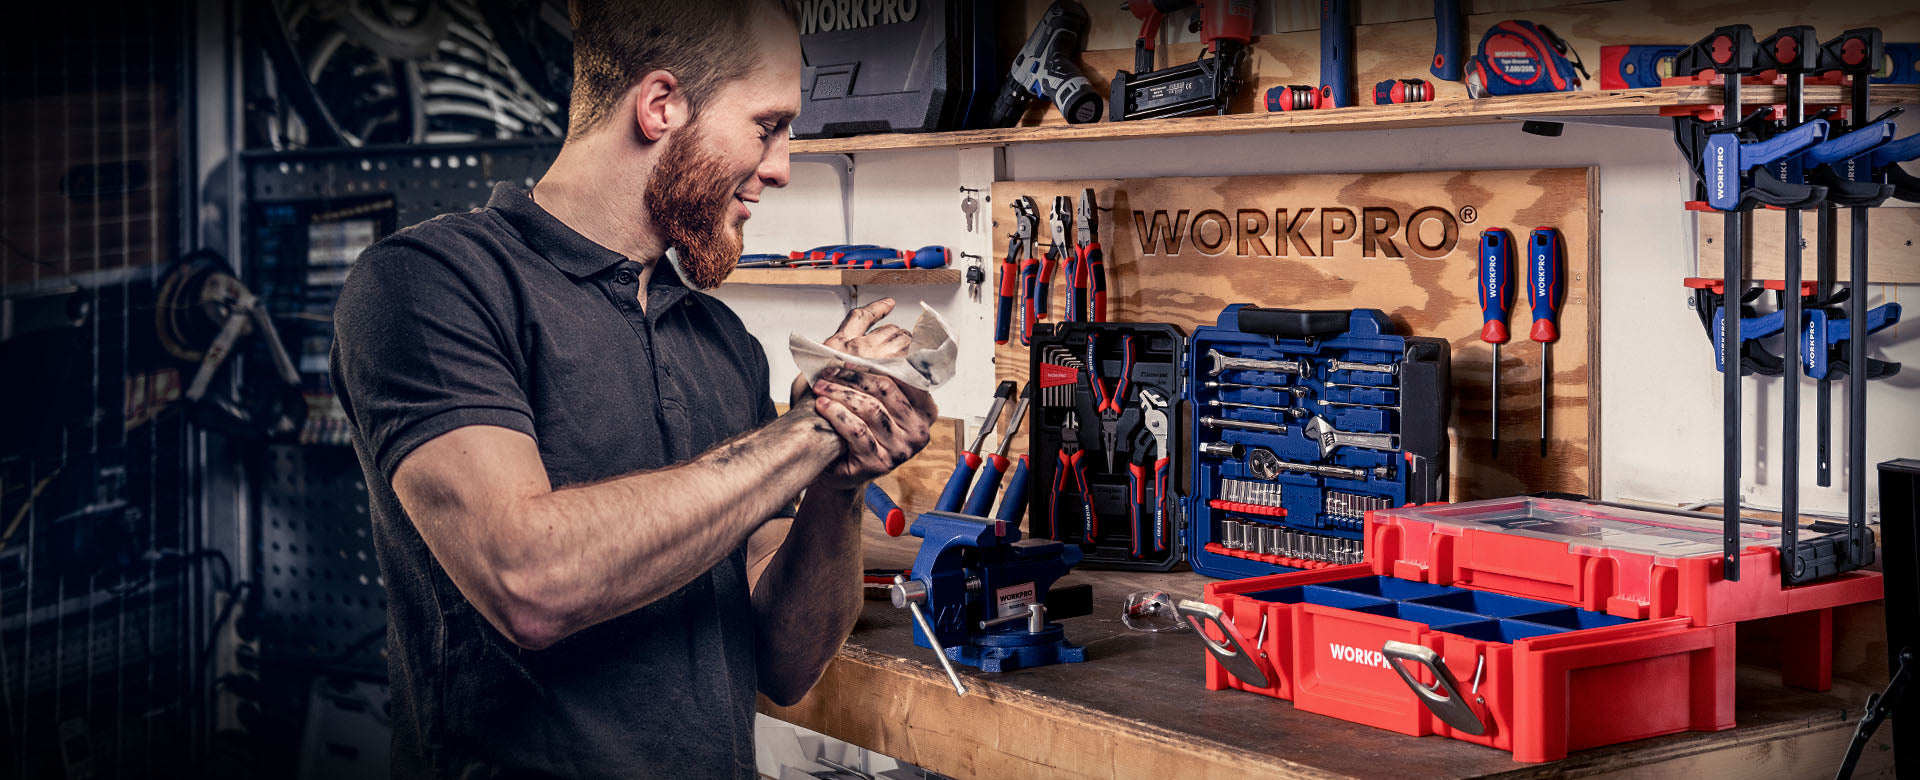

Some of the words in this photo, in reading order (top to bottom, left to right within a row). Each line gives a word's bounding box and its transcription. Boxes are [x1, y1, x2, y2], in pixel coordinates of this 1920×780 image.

[800, 0, 918, 35] WORKPRO
[1489, 255, 1497, 298] WORKPRO
[1538, 254, 1546, 297] WORKPRO
[1000, 590, 1033, 602] WORKPRO
[1329, 643, 1392, 669] WORKPR
